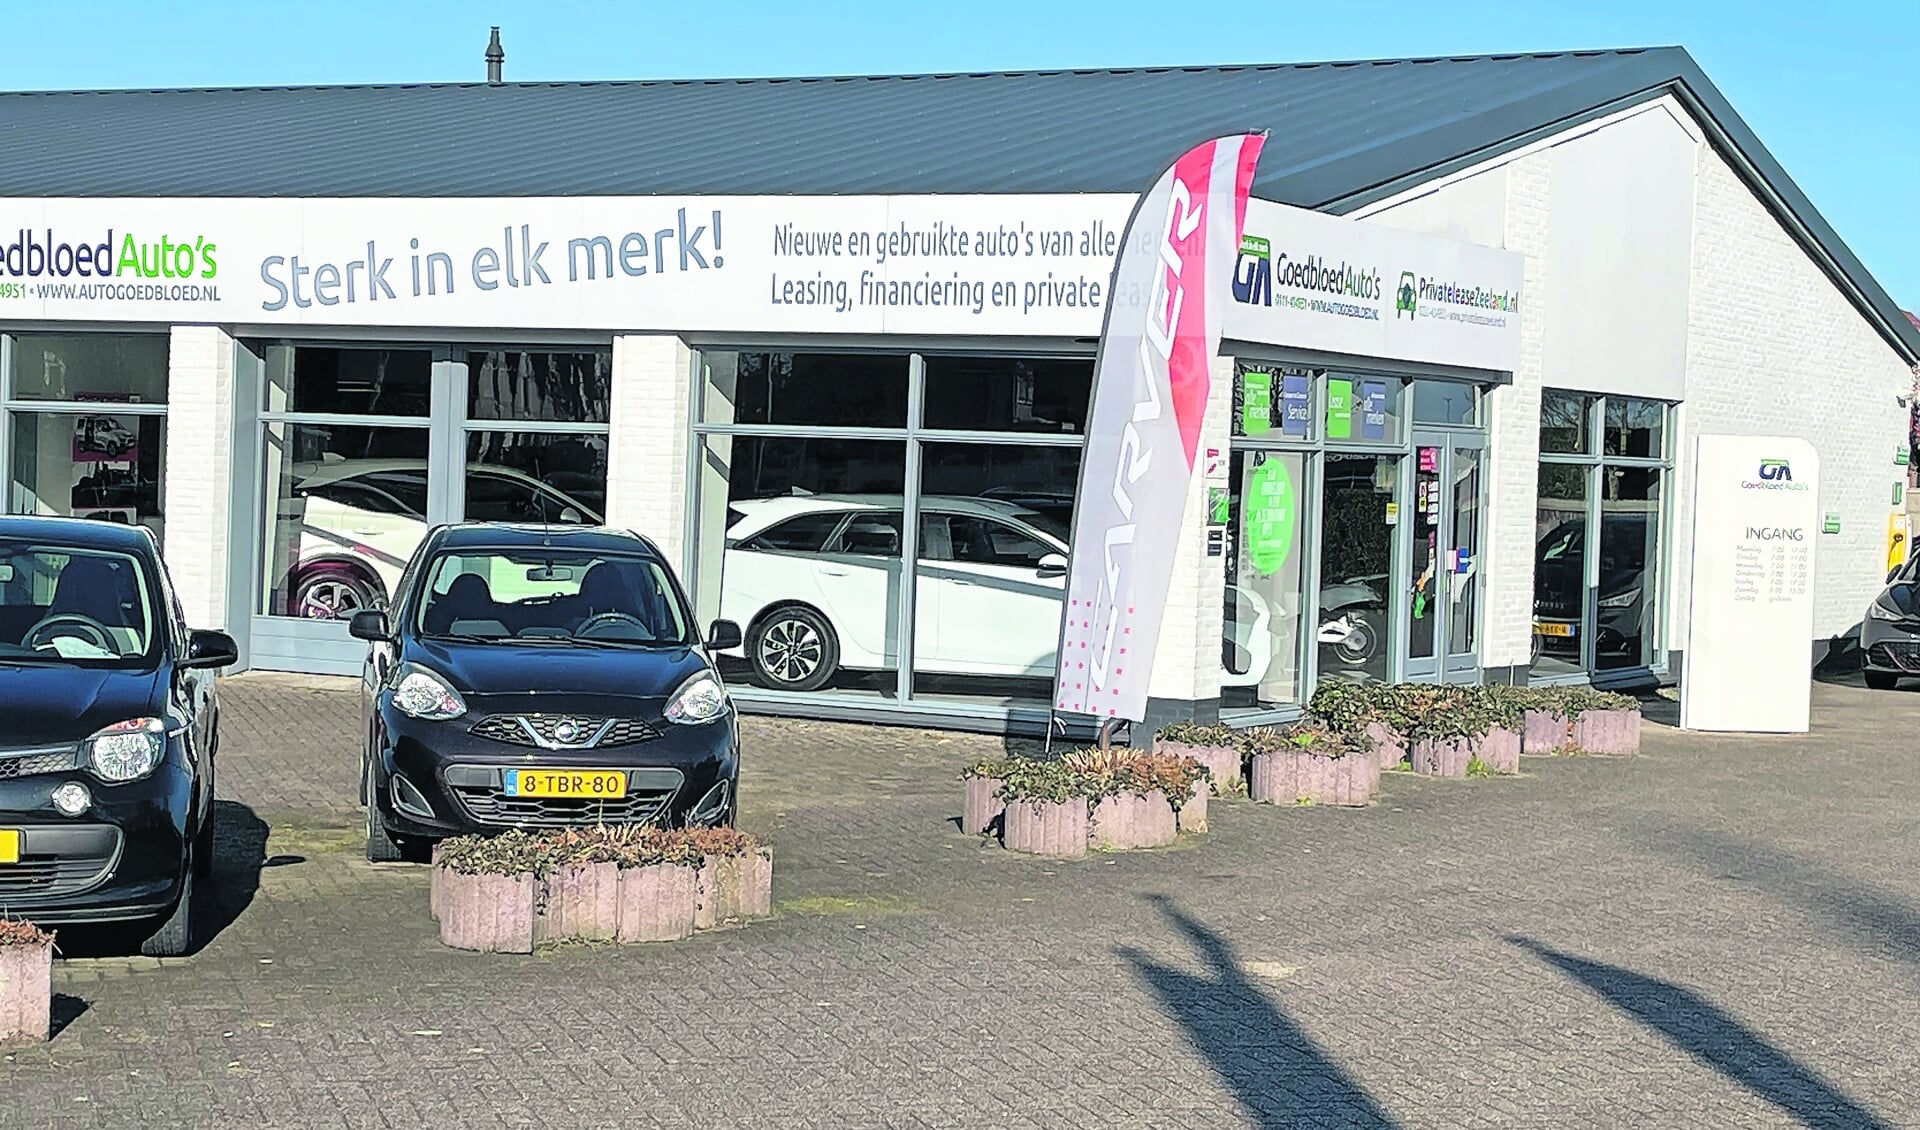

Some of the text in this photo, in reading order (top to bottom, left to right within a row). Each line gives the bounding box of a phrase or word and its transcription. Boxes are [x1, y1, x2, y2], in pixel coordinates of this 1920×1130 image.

[774, 221, 843, 257] Nieuwe
[848, 230, 870, 257] en
[876, 220, 969, 265] gebruikte
[974, 220, 1035, 257] auto's
[1040, 230, 1074, 257] van
[1079, 219, 1116, 257] alle
[260, 206, 725, 312] Sterk in elk merk!
[36, 283, 222, 302] WWW.AUTOGOEDBLOED.NL
[771, 270, 853, 313] Leasing,
[859, 269, 985, 315] financiering
[991, 280, 1017, 307] en
[1023, 271, 1101, 315] private
[1745, 526, 1804, 542] INGANG
[523, 775, 619, 793] 8-TBR-80
